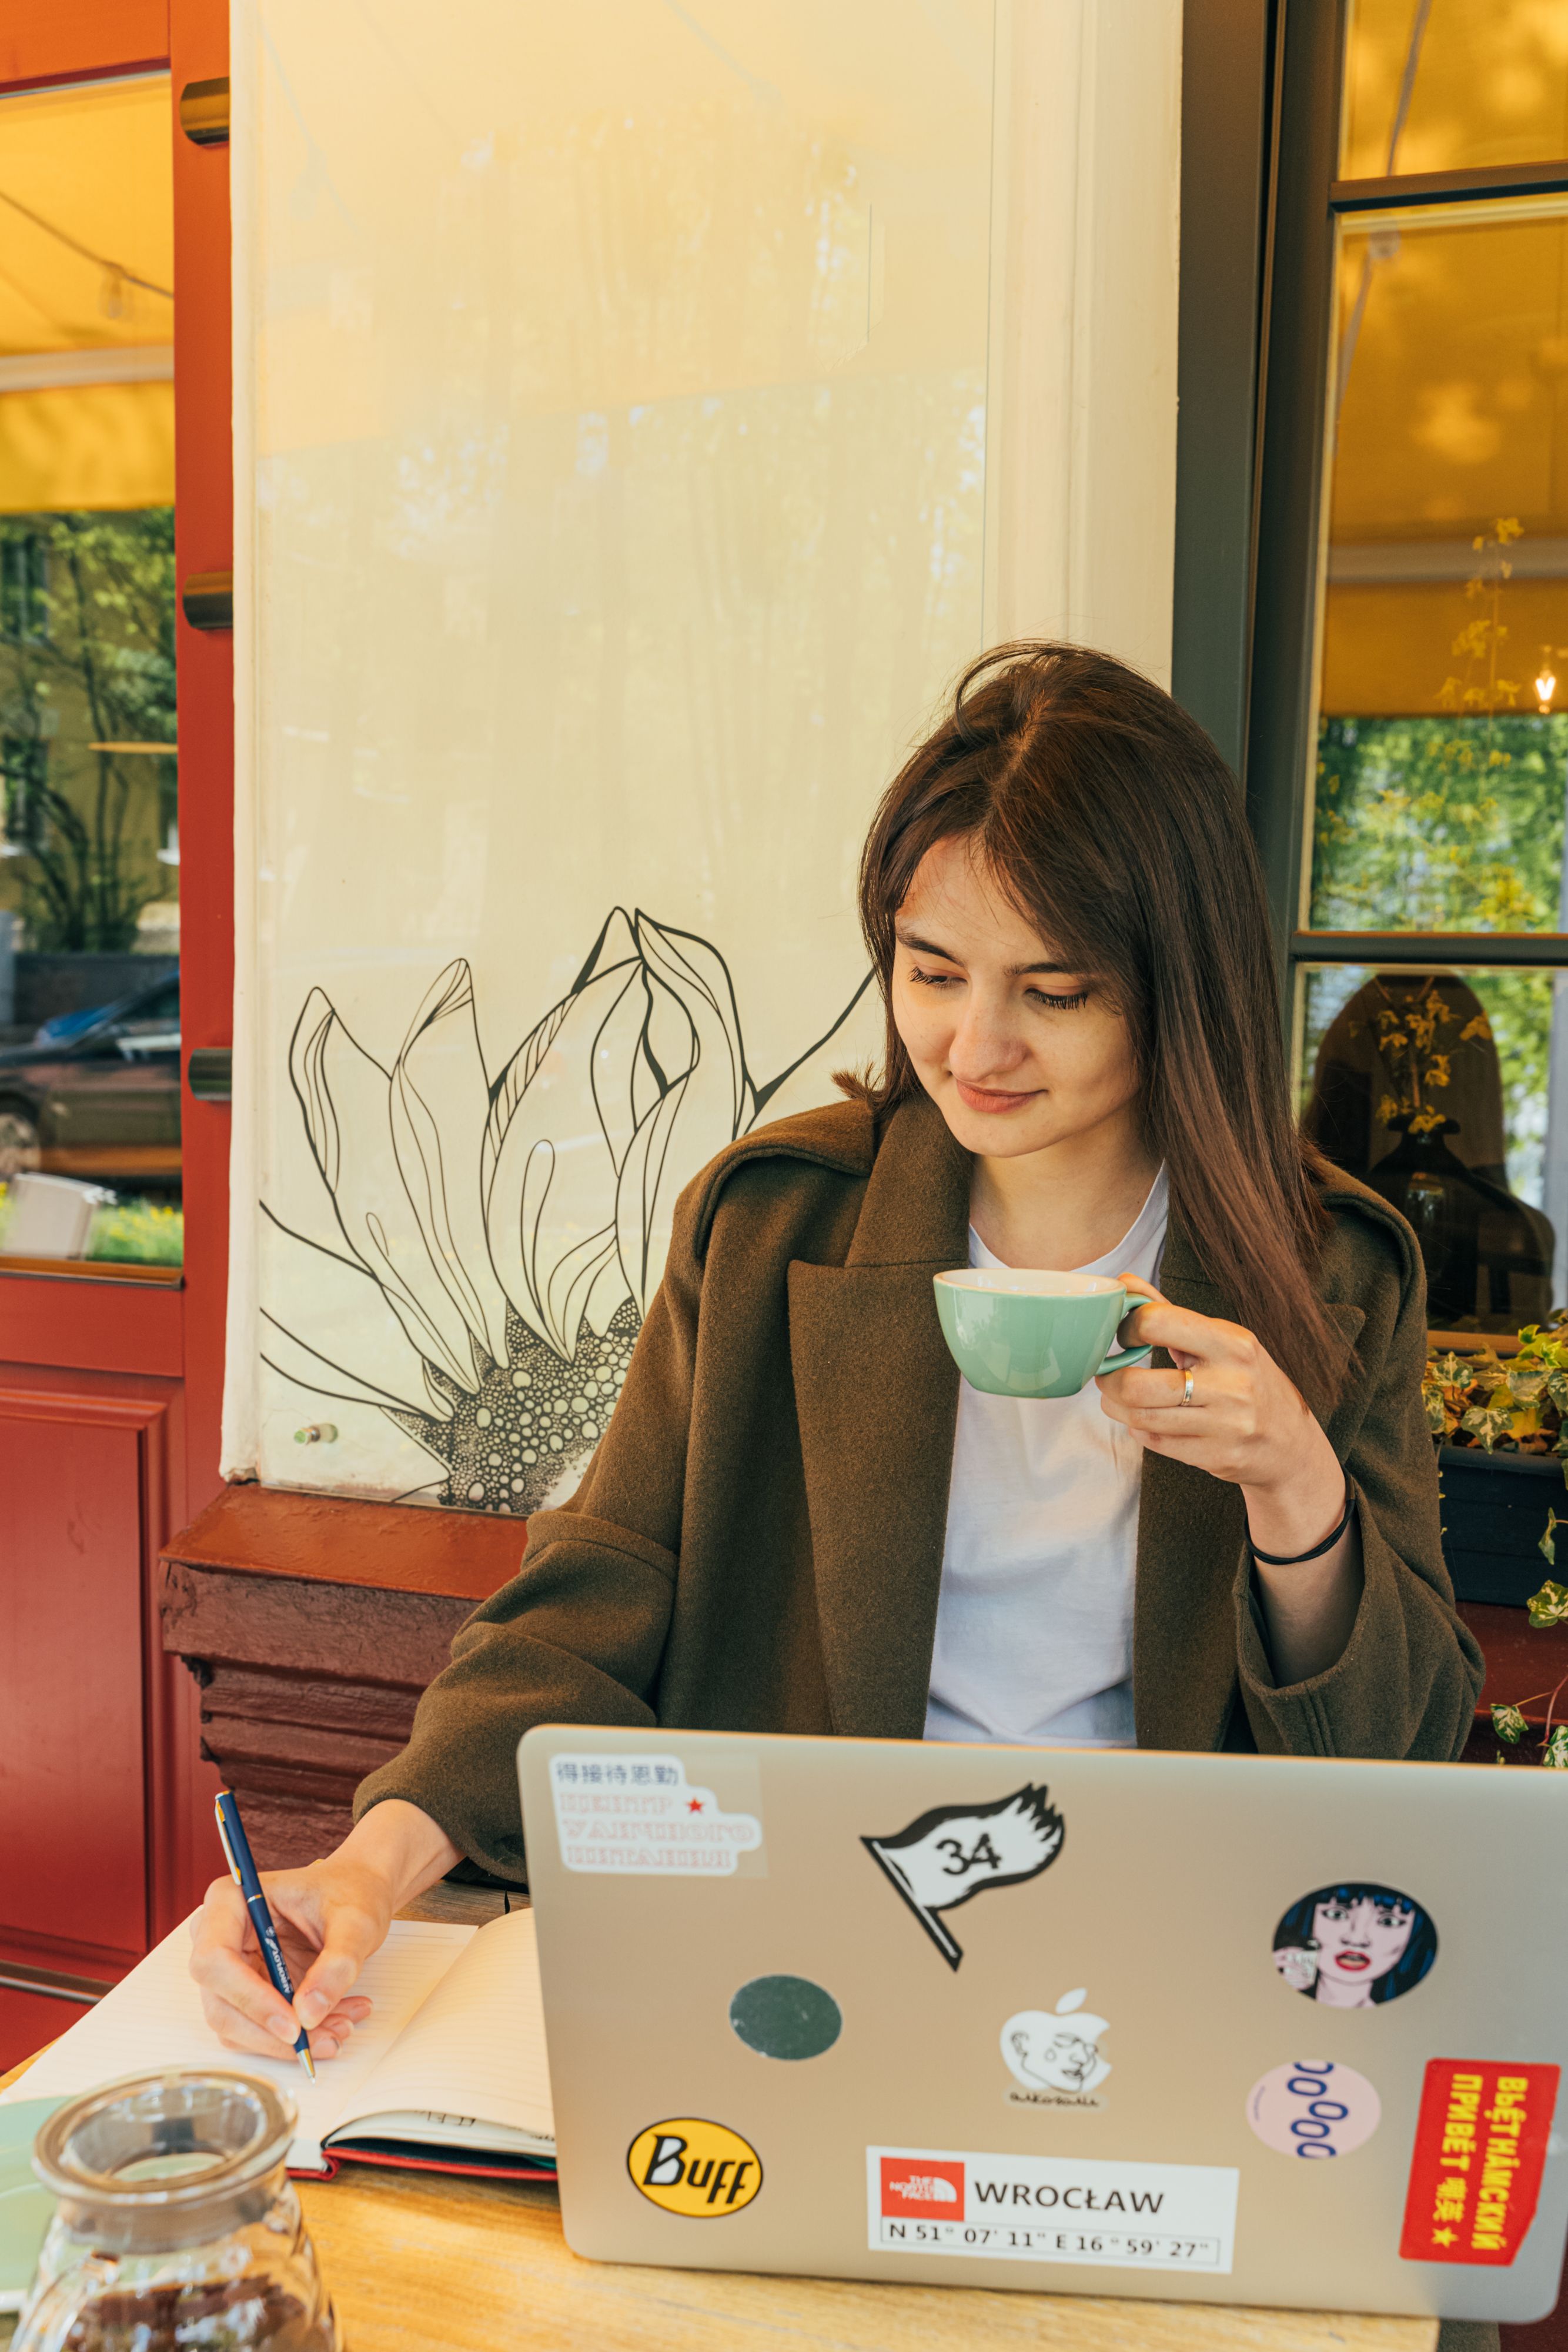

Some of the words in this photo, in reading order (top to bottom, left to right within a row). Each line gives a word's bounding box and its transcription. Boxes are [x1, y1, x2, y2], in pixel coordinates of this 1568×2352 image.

[936, 1833, 1002, 1875] 34
[272, 1949, 290, 1994] AEROFLOT
[974, 2180, 1164, 2213] WROCŁAW
[890, 2223, 906, 2239] N
[1056, 2235, 1066, 2250] E
